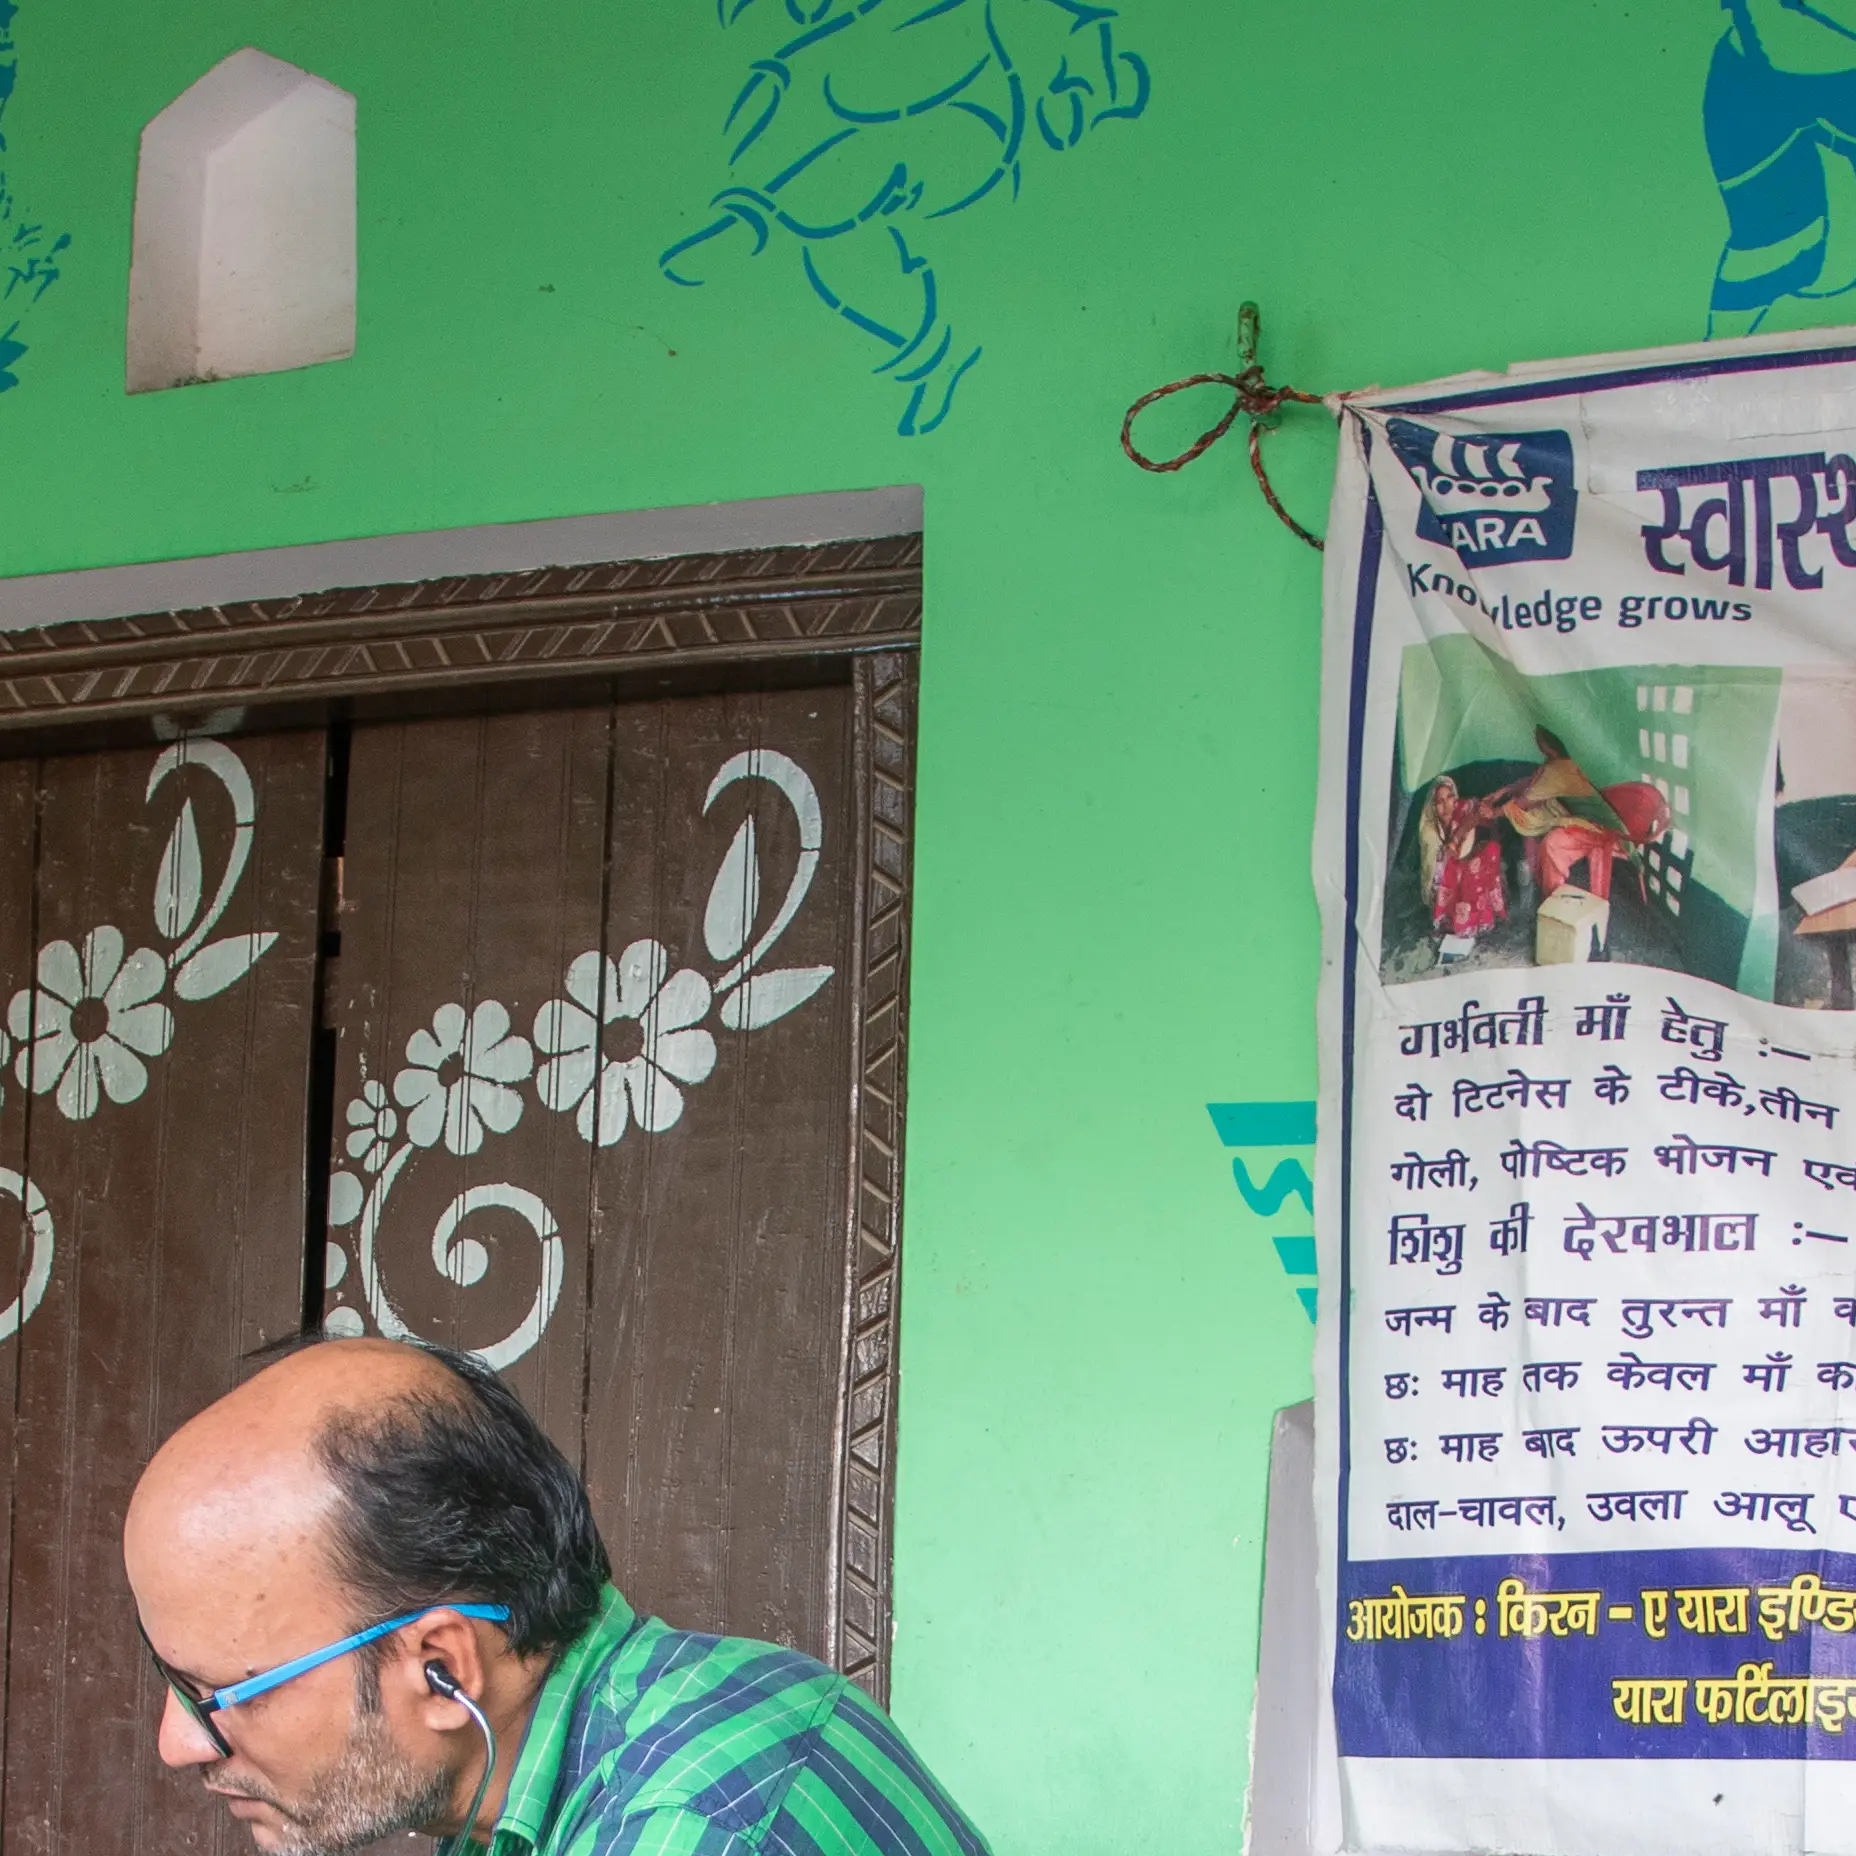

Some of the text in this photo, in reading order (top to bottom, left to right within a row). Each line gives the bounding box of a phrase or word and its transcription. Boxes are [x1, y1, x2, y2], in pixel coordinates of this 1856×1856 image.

[1441, 516, 1548, 553] ARA
[1618, 593, 1752, 629] grows
[1398, 995, 1550, 1059] गर्भवती
[1573, 992, 1632, 1042] माँ
[1660, 996, 1730, 1063] हेतु
[1393, 1082, 1434, 1122] दो
[1451, 1068, 1573, 1119] टिटनेस
[1592, 1064, 1633, 1106] के
[1389, 1148, 1479, 1192] गोली,
[1653, 1133, 1779, 1178] भोजन
[1387, 1213, 1467, 1277] शिशु
[1488, 1201, 1536, 1257] की
[1384, 1304, 1457, 1337] जन्म
[1477, 1291, 1512, 1332] के
[1523, 1297, 1599, 1328] बाद
[1620, 1298, 1734, 1340] तुरन्त
[1757, 1283, 1808, 1329] माँ
[1440, 1366, 1508, 1399] माह
[1521, 1361, 1583, 1393] तक
[1606, 1351, 1718, 1392] केवल
[1741, 1350, 1794, 1393] माँ
[1438, 1432, 1504, 1464] माह
[1521, 1426, 1582, 1459] बाद
[1600, 1416, 1719, 1456] ऊपरी
[1712, 1491, 1817, 1535] आलू
[1346, 1585, 1467, 1642] आयोजक
[1496, 1578, 1602, 1639] किरन
[1641, 1589, 1669, 1639] ए
[1675, 1586, 1751, 1635] यारा
[1610, 1678, 1689, 1725] यारा
